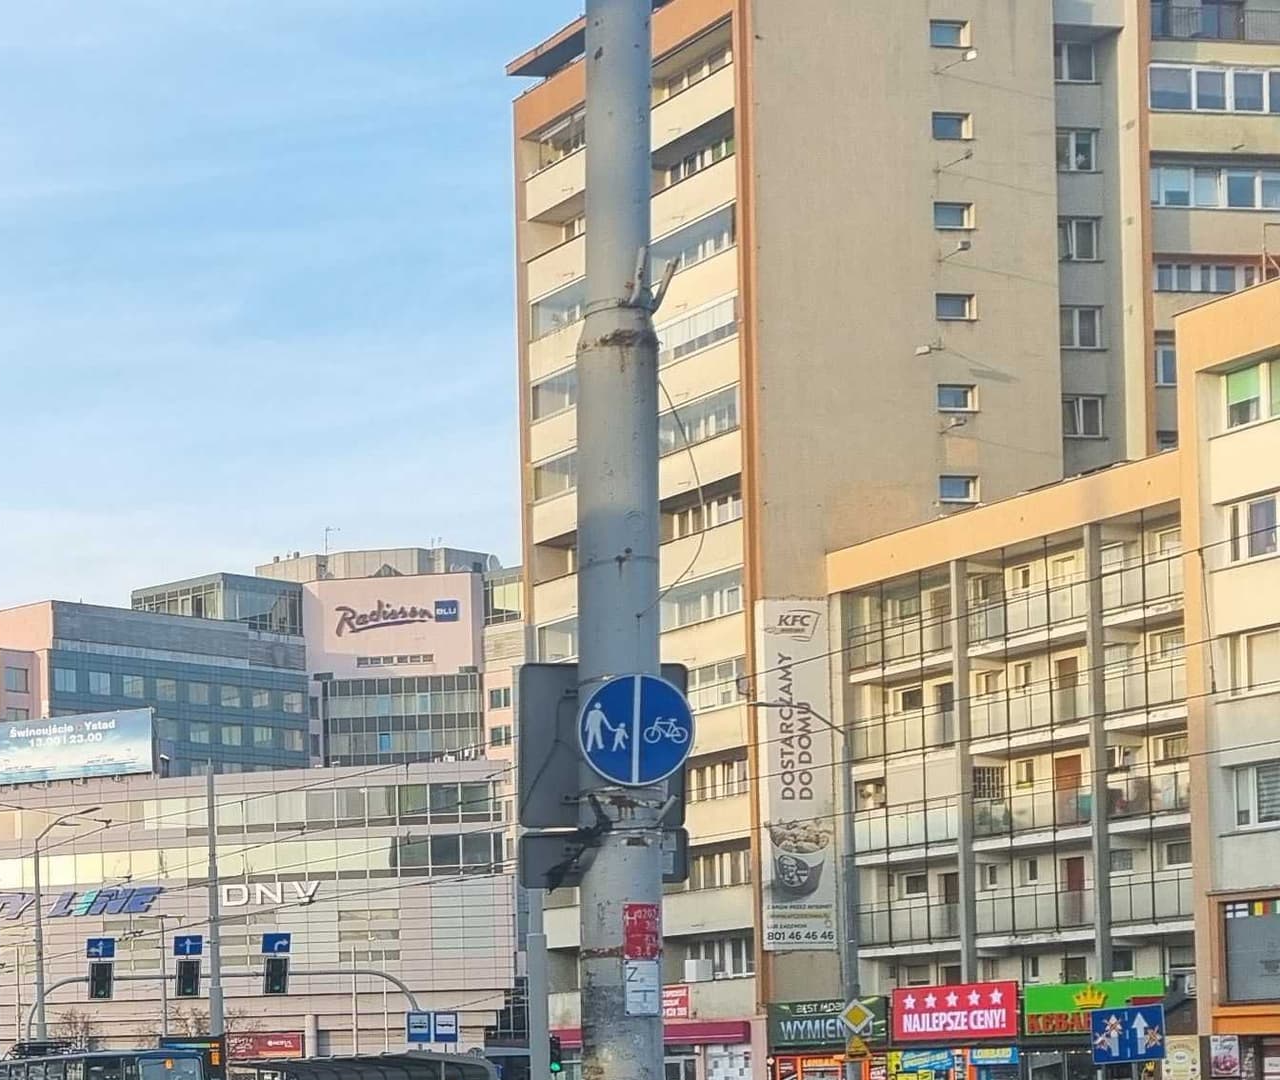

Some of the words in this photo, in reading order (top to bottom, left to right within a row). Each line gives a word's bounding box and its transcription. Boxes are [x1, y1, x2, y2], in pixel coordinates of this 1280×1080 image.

[335, 600, 433, 637] Radisson
[777, 614, 811, 627] KFC
[778, 652, 795, 801] DOSTARCZAMY
[797, 702, 812, 764] DOMU
[799, 771, 813, 801] DO
[48, 885, 166, 918] LINE
[221, 880, 320, 908] DNV
[767, 931, 786, 941] 801
[903, 1011, 968, 1033] NAJLEPSZE
[969, 1008, 1006, 1031] CENY!
